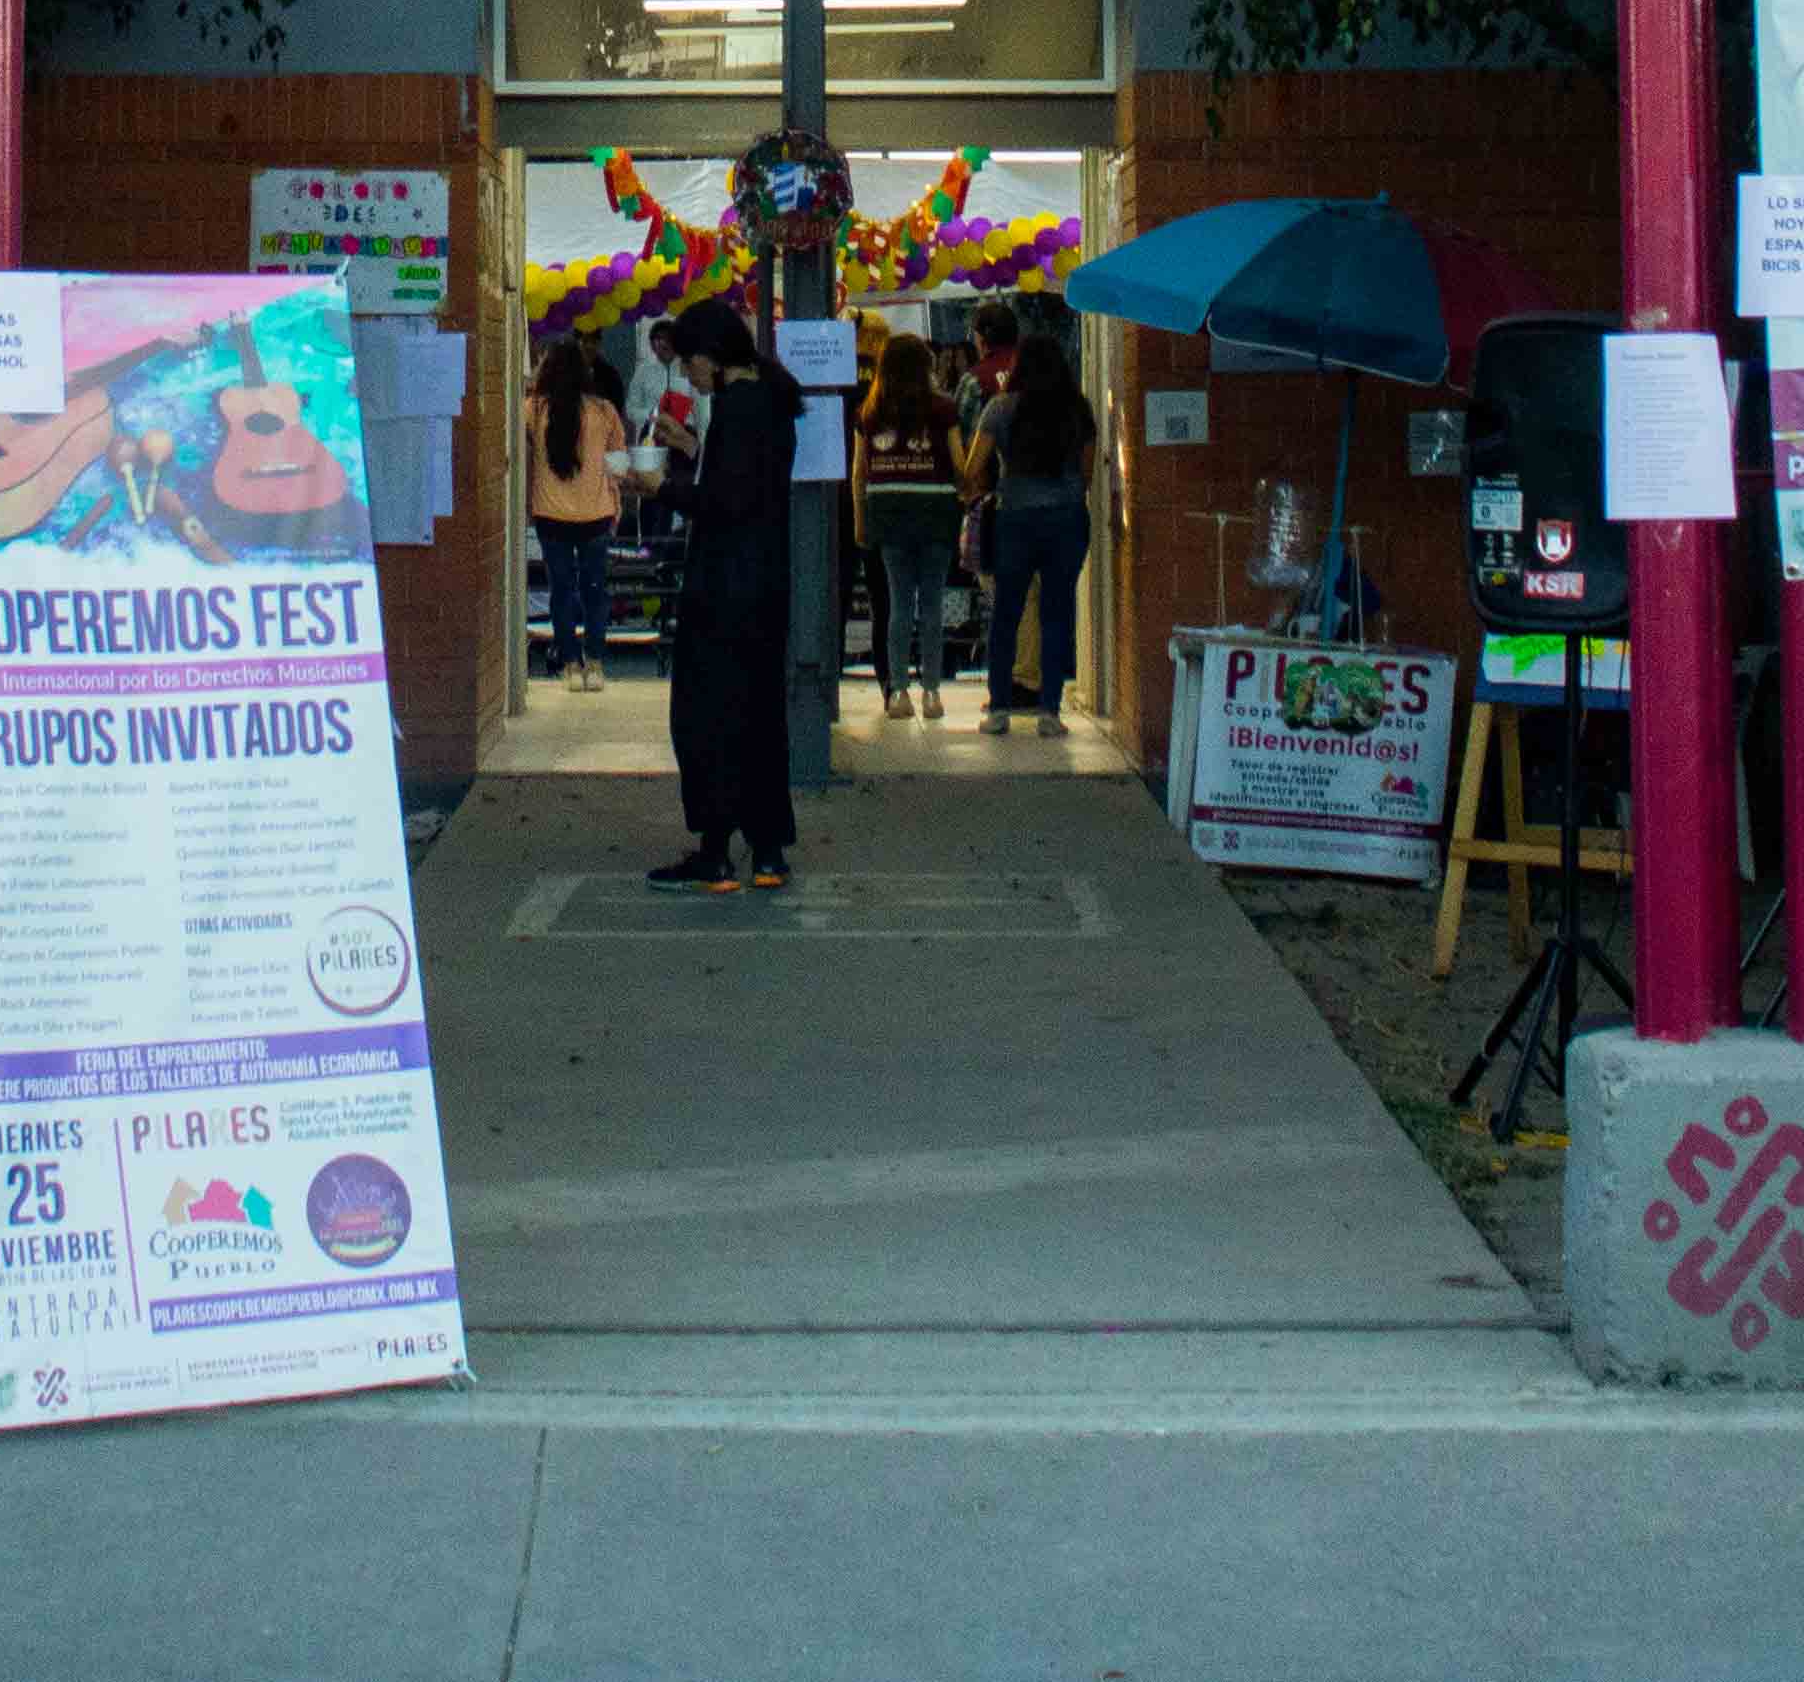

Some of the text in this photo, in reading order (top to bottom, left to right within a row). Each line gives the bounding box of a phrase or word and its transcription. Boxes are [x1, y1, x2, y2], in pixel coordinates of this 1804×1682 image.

[1768, 197, 1787, 209] LO
[1774, 218, 1804, 230] HOY
[1762, 259, 1800, 271] BICIS
[250, 580, 363, 647] FEST
[0, 669, 115, 692] Internacional
[116, 670, 148, 692] por
[152, 669, 181, 689] los
[185, 661, 274, 687] Derechos
[277, 661, 368, 683] Musicales
[128, 698, 354, 764] INVITADOS
[119, 1049, 144, 1070] DEL
[6, 1161, 67, 1227] 25
